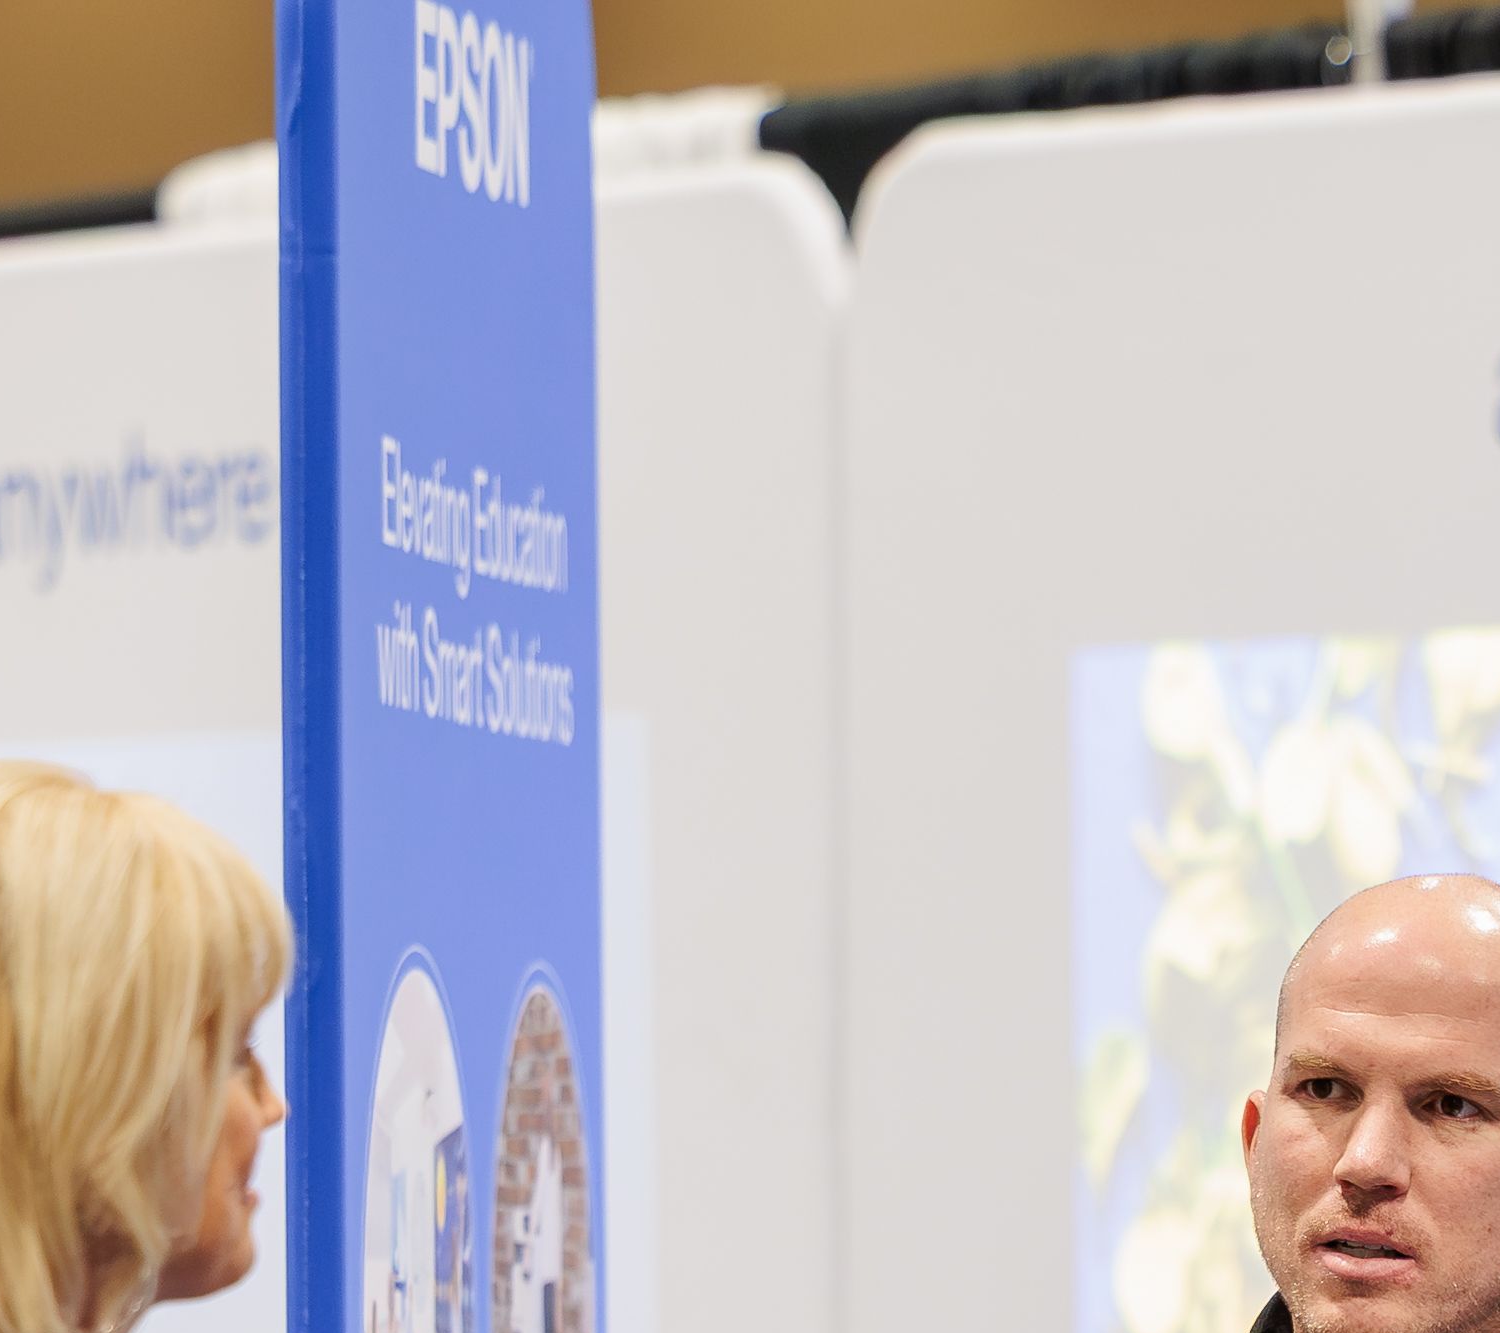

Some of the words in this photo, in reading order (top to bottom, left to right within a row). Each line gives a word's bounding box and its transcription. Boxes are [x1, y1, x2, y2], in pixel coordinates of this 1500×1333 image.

[414, 0, 529, 207] EPSON
[381, 432, 471, 600] Elevating
[473, 465, 569, 594] Education
[376, 599, 421, 712] with
[423, 604, 484, 730] Smart
[487, 620, 575, 747] Solutions
